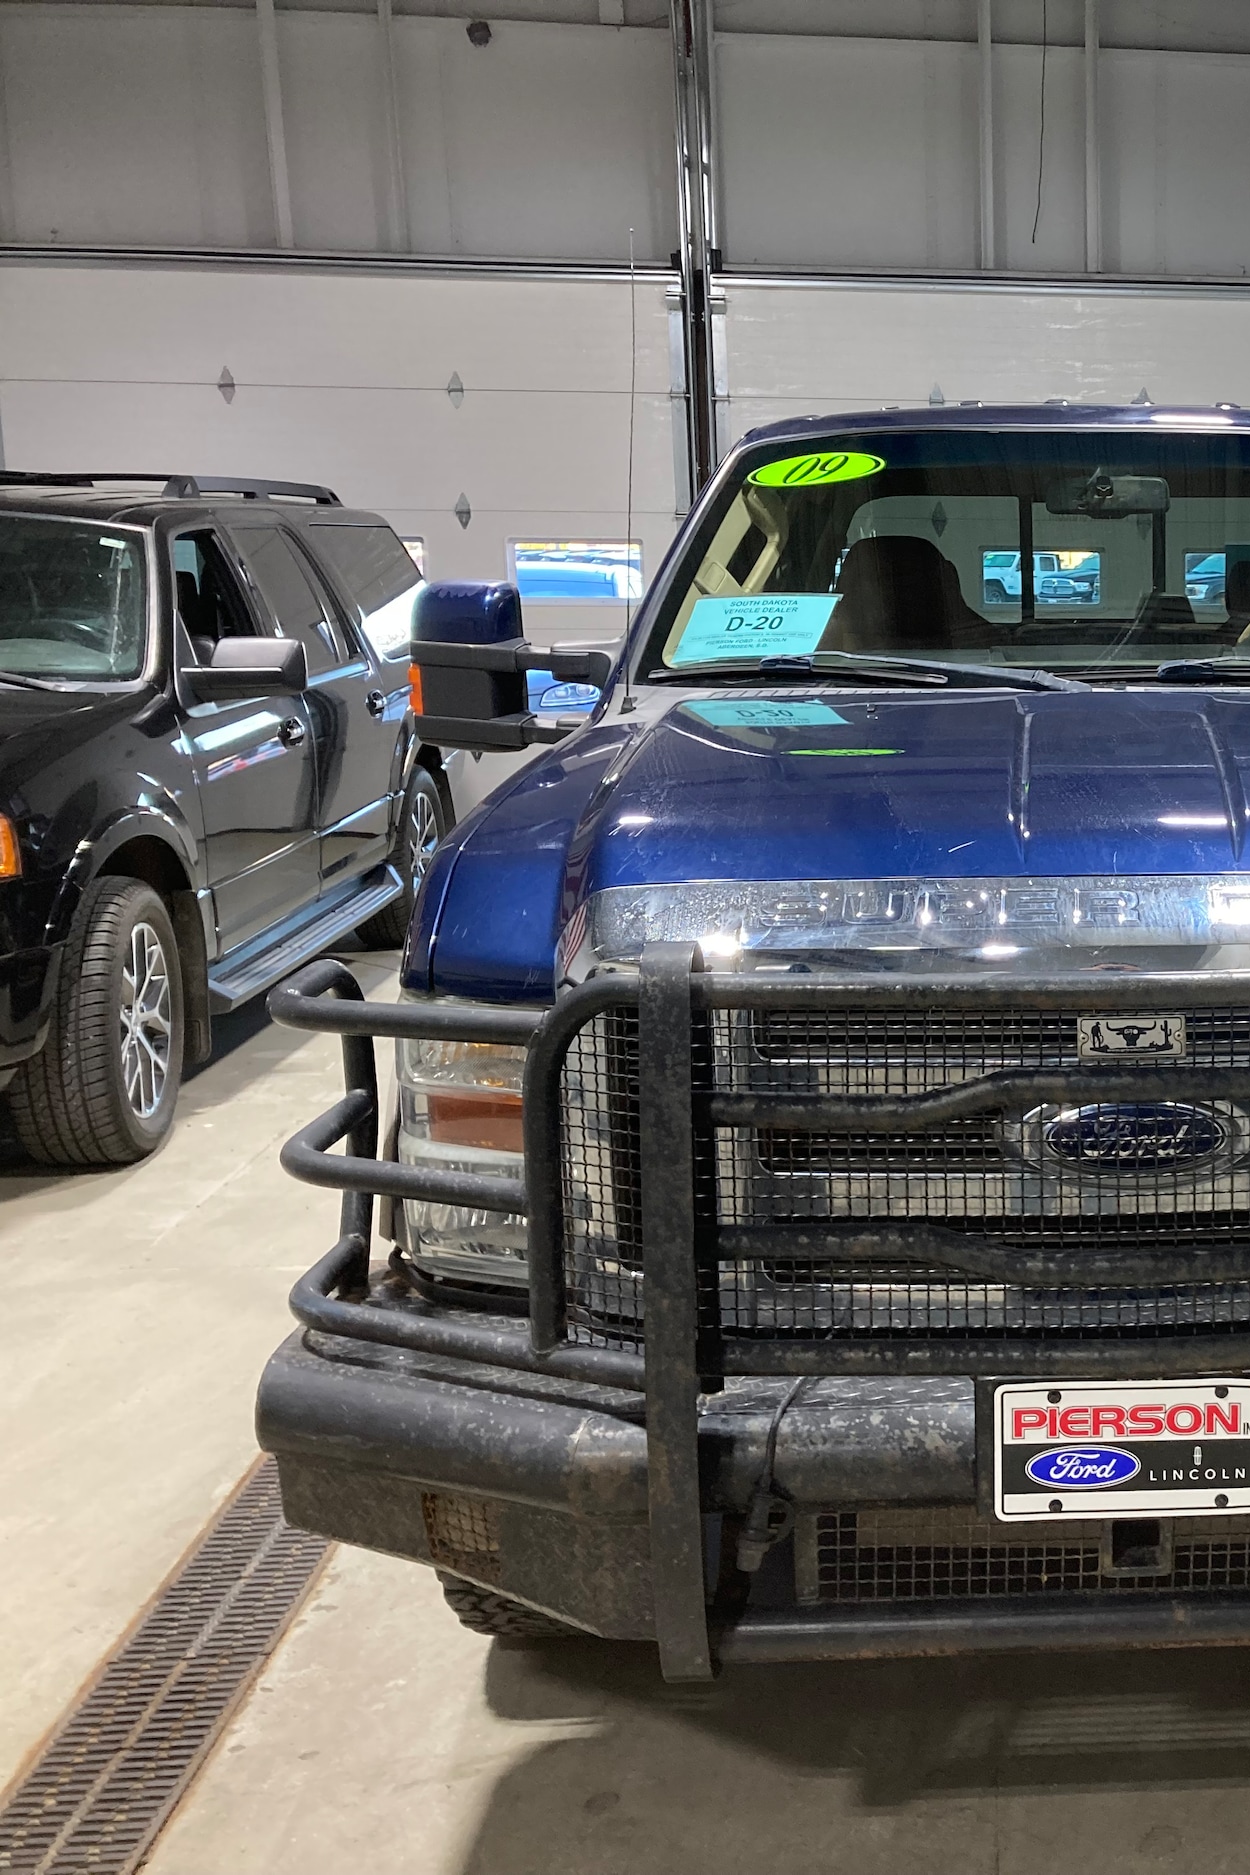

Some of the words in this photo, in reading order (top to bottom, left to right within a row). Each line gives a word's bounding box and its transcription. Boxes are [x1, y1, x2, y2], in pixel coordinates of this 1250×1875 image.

[782, 454, 850, 485] 09
[724, 607, 760, 615] VEHICLE
[724, 616, 784, 632] D-20
[759, 887, 1141, 926] SUPER
[1011, 1402, 1242, 1440] PIERSON
[1048, 1452, 1117, 1480] Ford
[1149, 1467, 1247, 1482] LINCOLN
